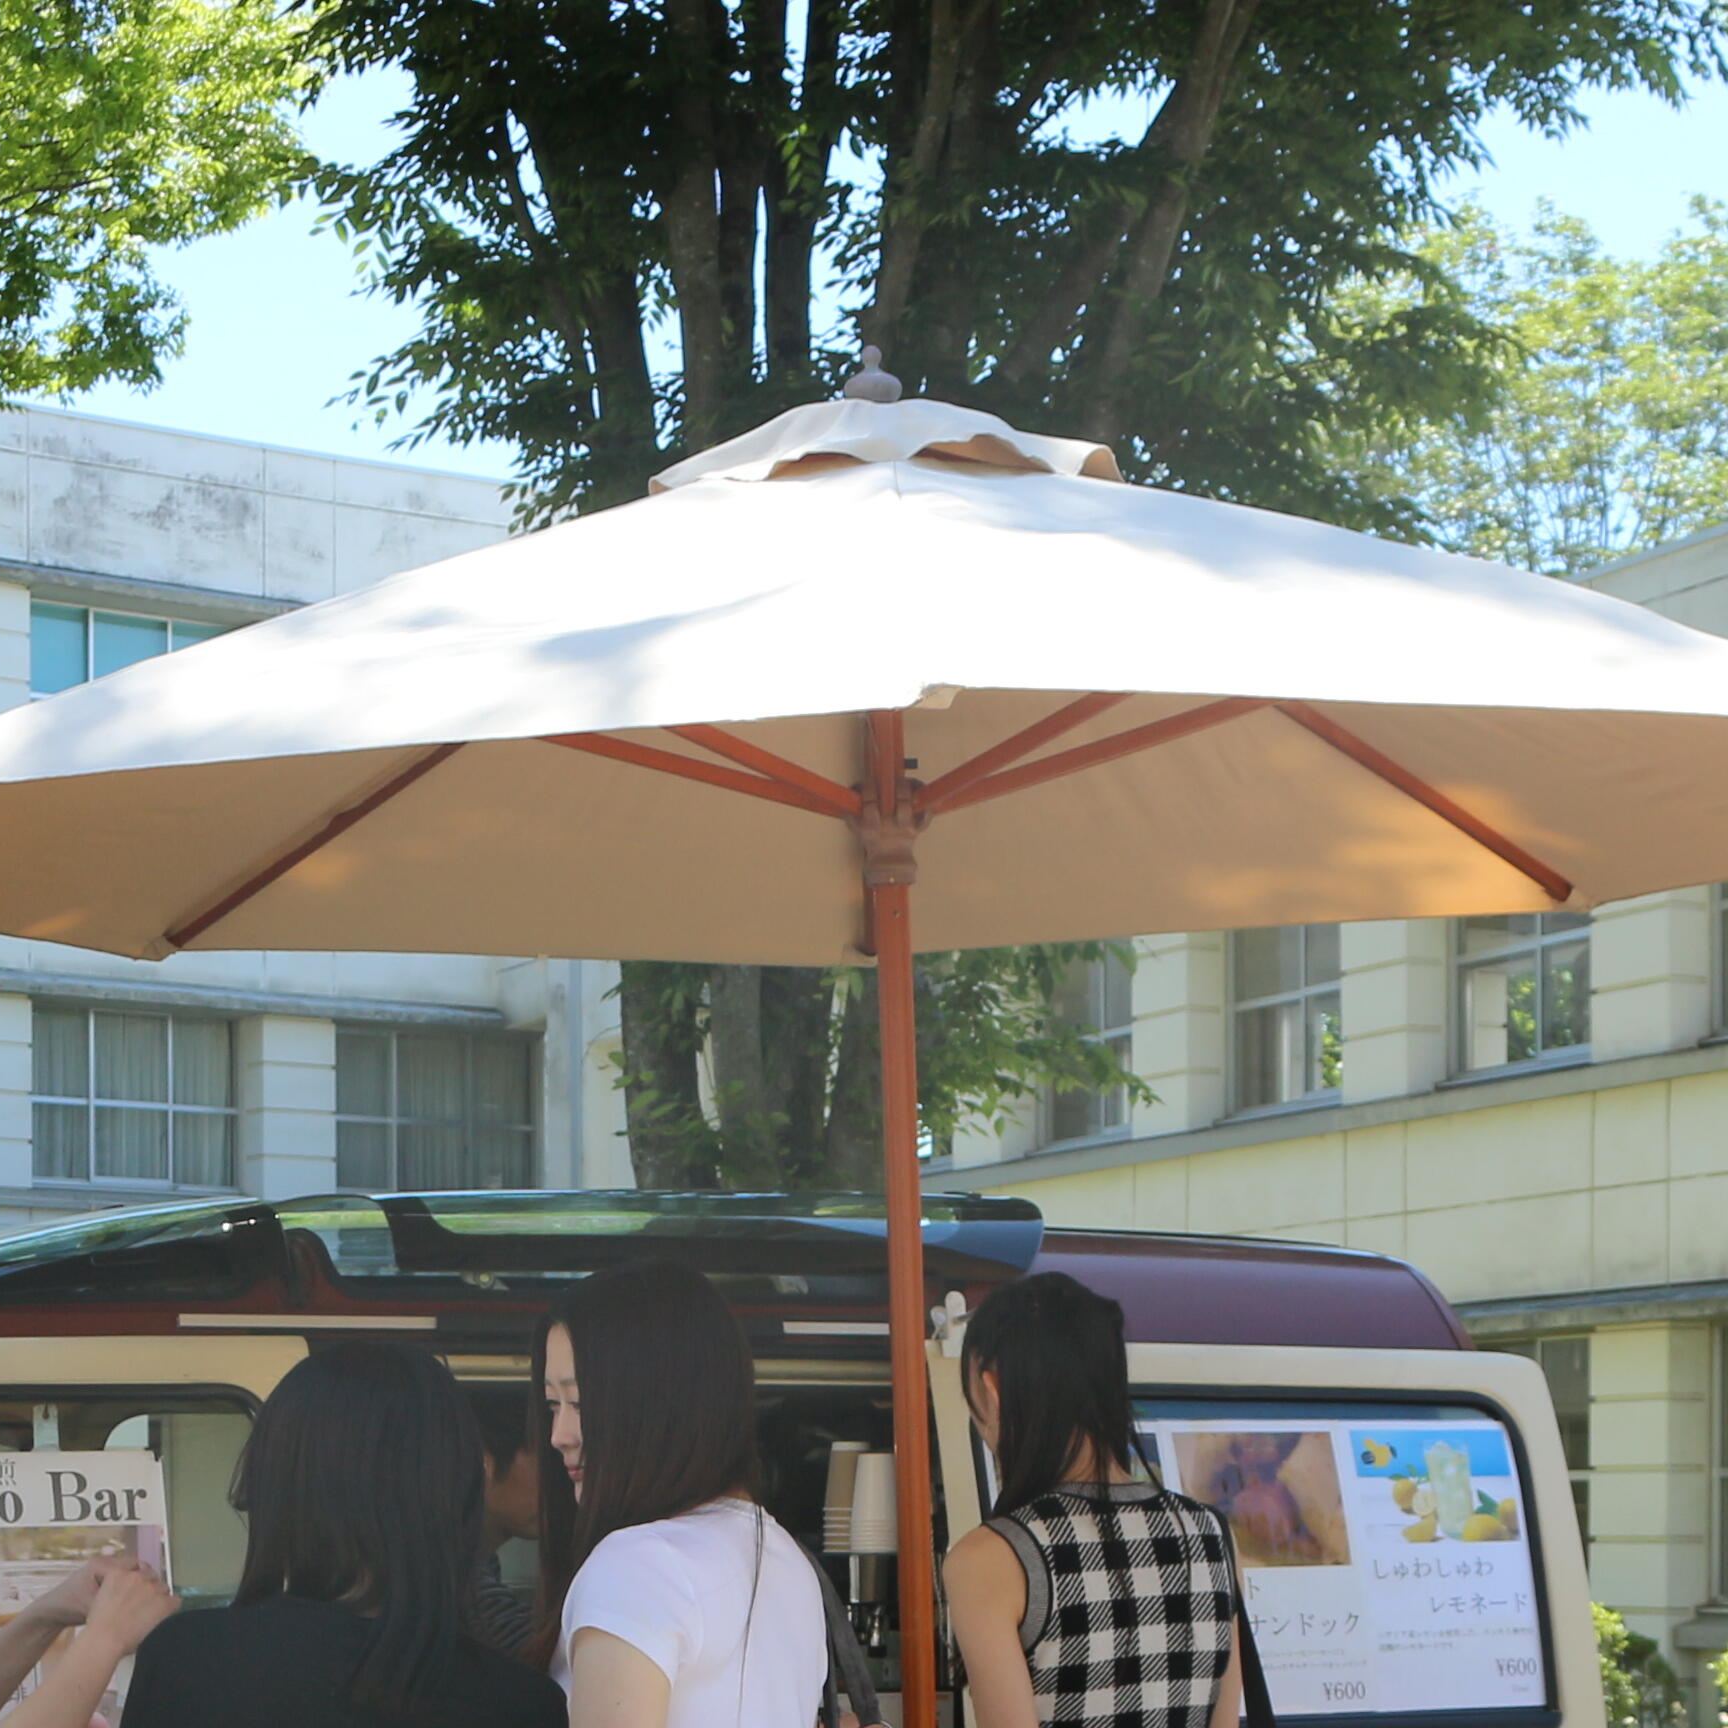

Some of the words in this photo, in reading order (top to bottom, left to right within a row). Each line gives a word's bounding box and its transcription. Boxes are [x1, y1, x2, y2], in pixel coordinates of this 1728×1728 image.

[46, 1470, 148, 1523] Bar
[1372, 1555, 1496, 1580] しゅわしゅわ
[1428, 1591, 1530, 1615] レモネード
[1494, 1657, 1538, 1677] ¥600
[1322, 1680, 1367, 1701] ¥600
